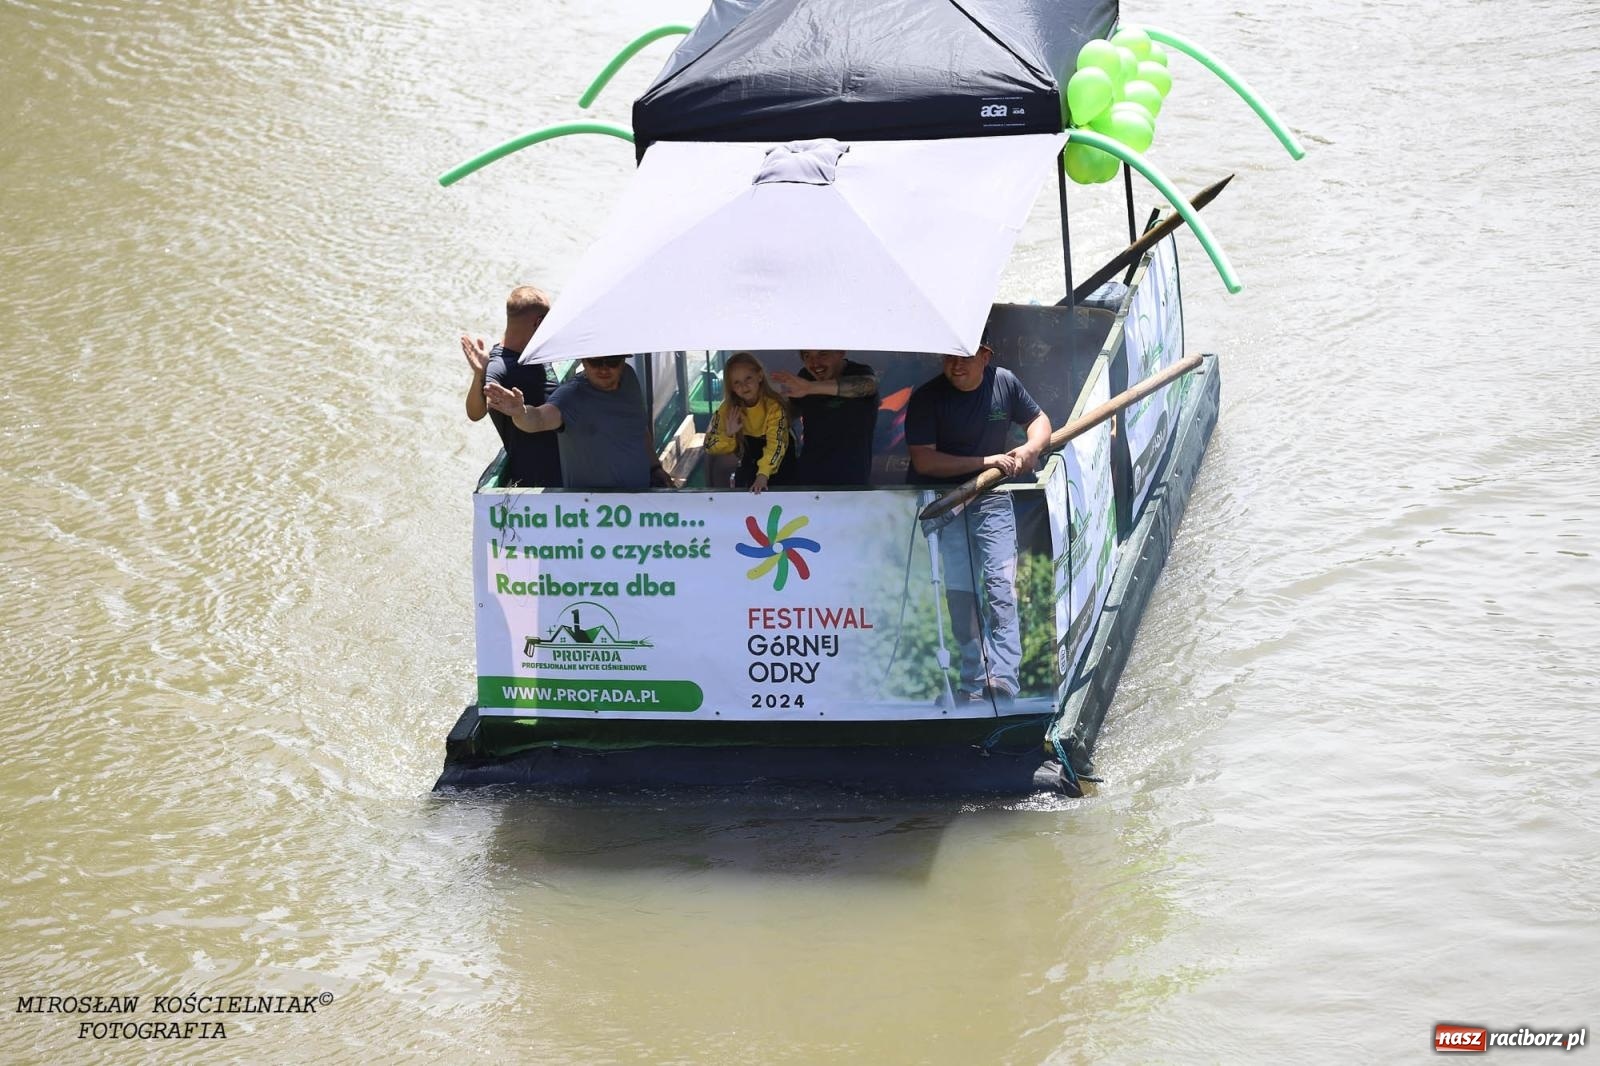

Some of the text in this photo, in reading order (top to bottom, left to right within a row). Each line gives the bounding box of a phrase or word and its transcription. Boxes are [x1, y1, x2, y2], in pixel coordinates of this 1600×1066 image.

[489, 504, 705, 528] Unia lat 20 ma...
[491, 537, 712, 565] I z nami o czystość
[495, 573, 676, 597] Raciborza dba
[748, 607, 874, 630] FESTIWAL
[521, 662, 648, 671] PROFESJONALNE MYCIE CIŚNIENIOWE
[552, 649, 622, 662] PROFADA
[748, 661, 821, 684] ODRY
[502, 686, 660, 704] WWW.PROFADA.PL
[751, 694, 805, 708] 2024
